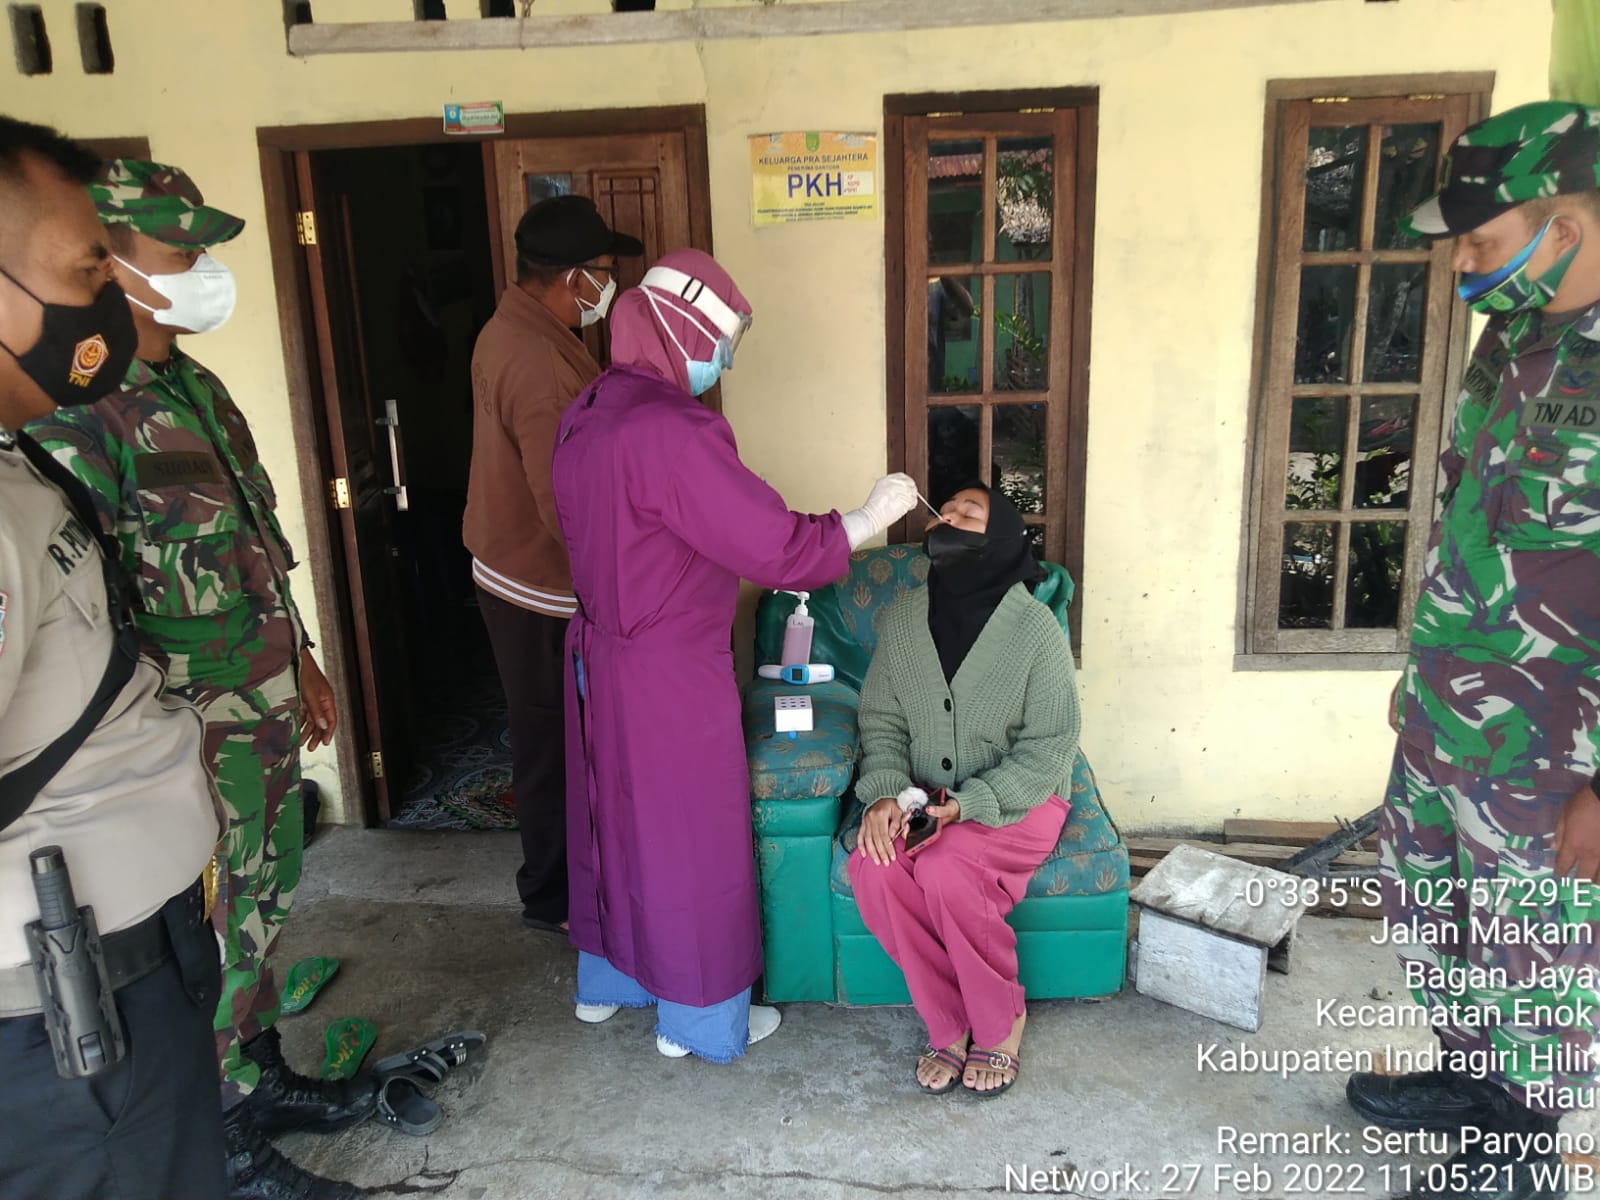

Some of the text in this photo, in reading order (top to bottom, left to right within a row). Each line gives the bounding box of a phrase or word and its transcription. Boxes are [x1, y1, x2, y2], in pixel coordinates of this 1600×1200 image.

[758, 153, 868, 165] KELUARGA PRA SEJAHTERA
[787, 172, 842, 198] PKH
[68, 373, 92, 388] TNI
[1534, 402, 1597, 427] TNI AD
